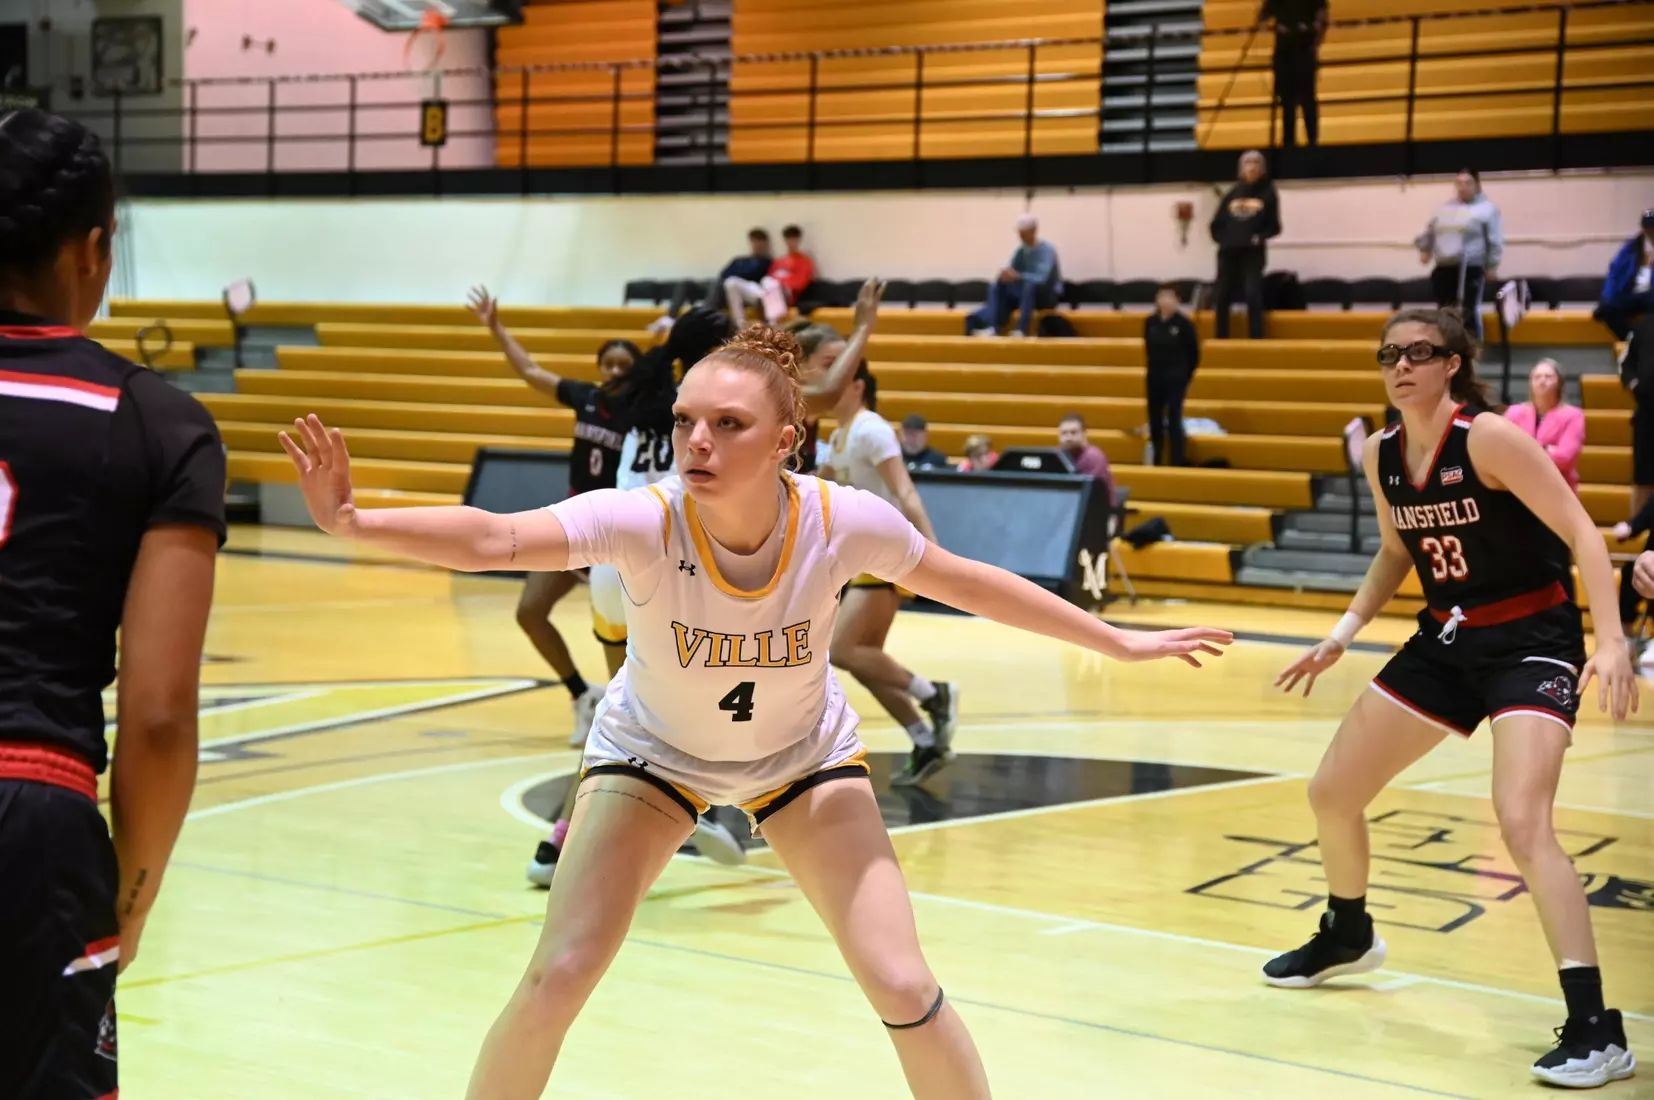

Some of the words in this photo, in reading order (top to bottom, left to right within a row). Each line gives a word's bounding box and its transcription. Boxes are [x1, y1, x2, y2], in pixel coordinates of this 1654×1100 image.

[630, 429, 674, 473] 20
[1391, 497, 1480, 530] ANSFIELD
[1421, 535, 1469, 582] 33
[671, 619, 812, 668] VILLE
[718, 681, 756, 722] 4
